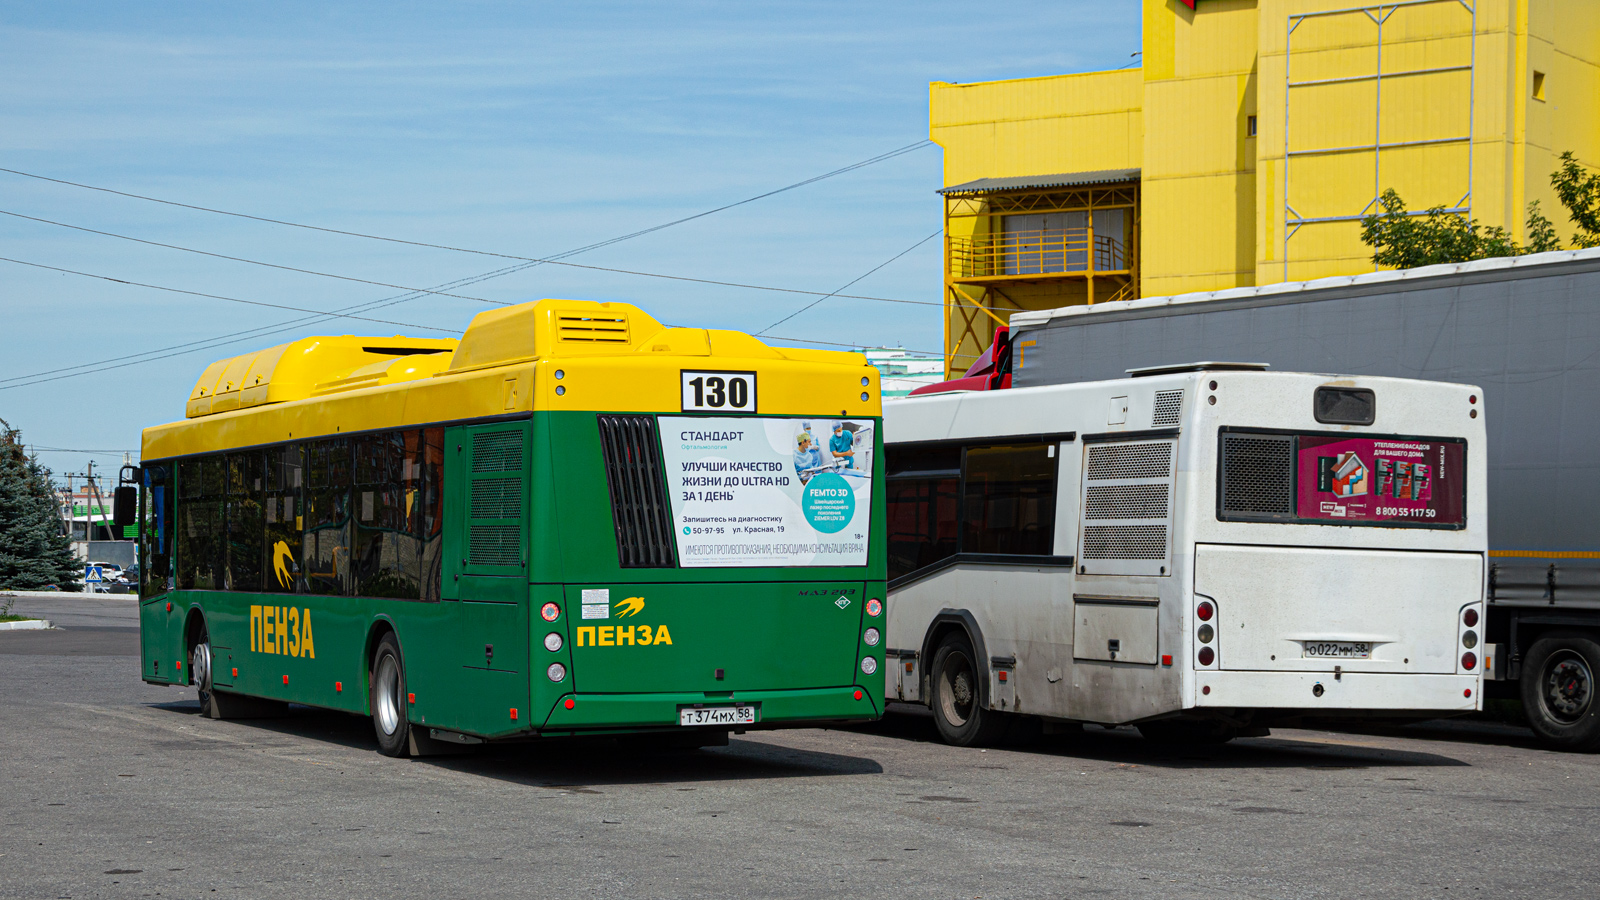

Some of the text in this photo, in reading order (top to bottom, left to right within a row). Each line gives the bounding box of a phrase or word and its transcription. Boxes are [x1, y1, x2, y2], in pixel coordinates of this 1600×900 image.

[689, 377, 748, 408] 130
[680, 431, 744, 441] СТАНДАРТ
[682, 462, 782, 472] УЛУЧШИ КАЧЕСТВО
[682, 477, 790, 488] ЖИЗНИ ДО ULTRA HD
[682, 492, 696, 501] ЗА
[698, 492, 702, 501] 1
[810, 489, 848, 497] FEMTO 3D
[1376, 507, 1382, 516] 8
[1382, 507, 1398, 516] 800
[1398, 508, 1408, 517] 55
[1410, 508, 1424, 518] 117
[1425, 508, 1436, 518] 50
[732, 527, 744, 535] ул.
[744, 526, 776, 535] Красная,
[685, 545, 714, 556] ИМЕЮТСЯ
[772, 544, 808, 555] НЕОБХОДИМА
[808, 543, 848, 554] КОНСУЛЬТАЦИЯ
[848, 542, 864, 553] ВРАЧА
[250, 605, 315, 659] ПЕНЗА
[577, 625, 672, 647] ПЕНЗА
[1355, 644, 1366, 652] 58
[738, 708, 750, 718] 58
